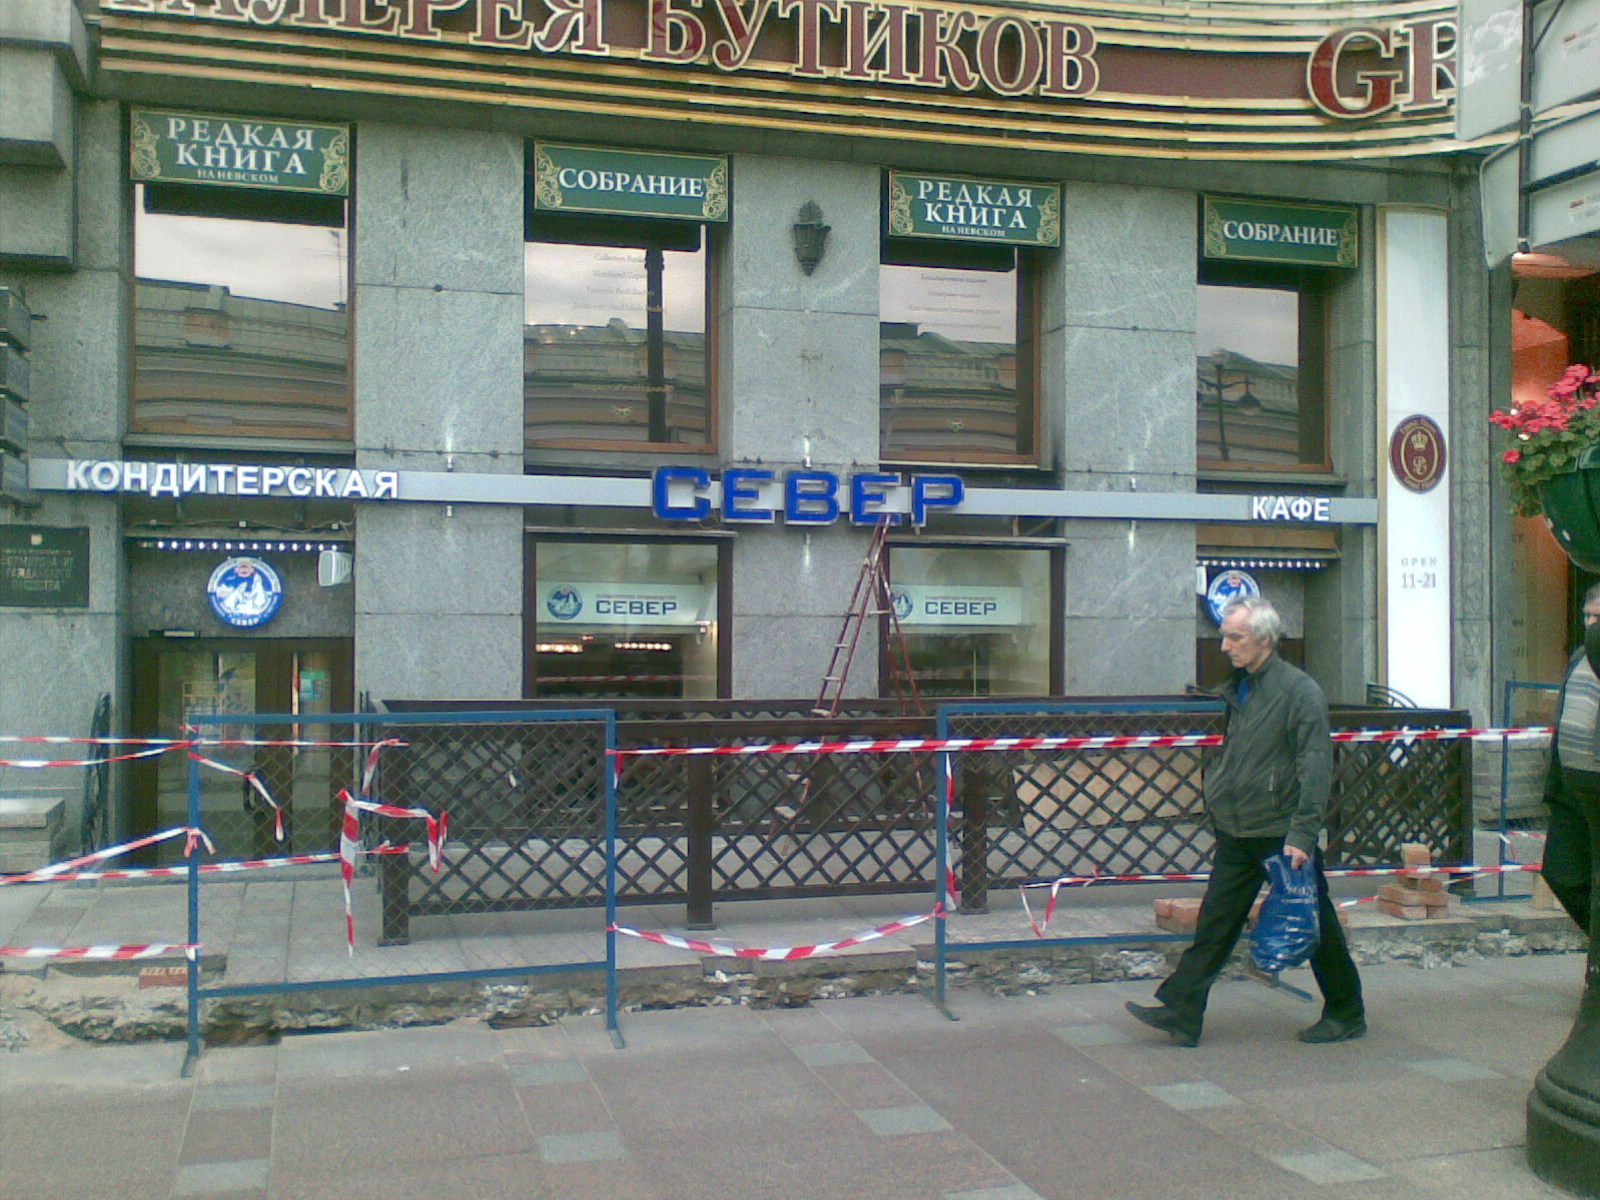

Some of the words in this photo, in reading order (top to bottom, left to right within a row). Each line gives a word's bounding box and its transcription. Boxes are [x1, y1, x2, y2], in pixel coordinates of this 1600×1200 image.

[641, 0, 1099, 99] БУТИКОВ
[166, 117, 315, 151] РЕДКАЯ
[175, 143, 307, 175] КНИГА
[216, 171, 280, 184] НЕВСКОМ
[559, 166, 704, 199] СОБРАНИЕ
[917, 180, 1033, 208] РЕДКАЯ
[925, 202, 1028, 229] КНИГА
[957, 226, 1006, 238] НЕВСКОМ
[1223, 220, 1338, 247] СОБРАНИЕ
[66, 461, 399, 500] КОНДИТЕРСКАЯ
[651, 466, 965, 528] СЕВЕР
[1251, 494, 1331, 522] КАФЕ
[1401, 571, 1436, 589] 11-21
[596, 599, 677, 616] СЕВЕР
[925, 601, 997, 616] СЕВЕР
